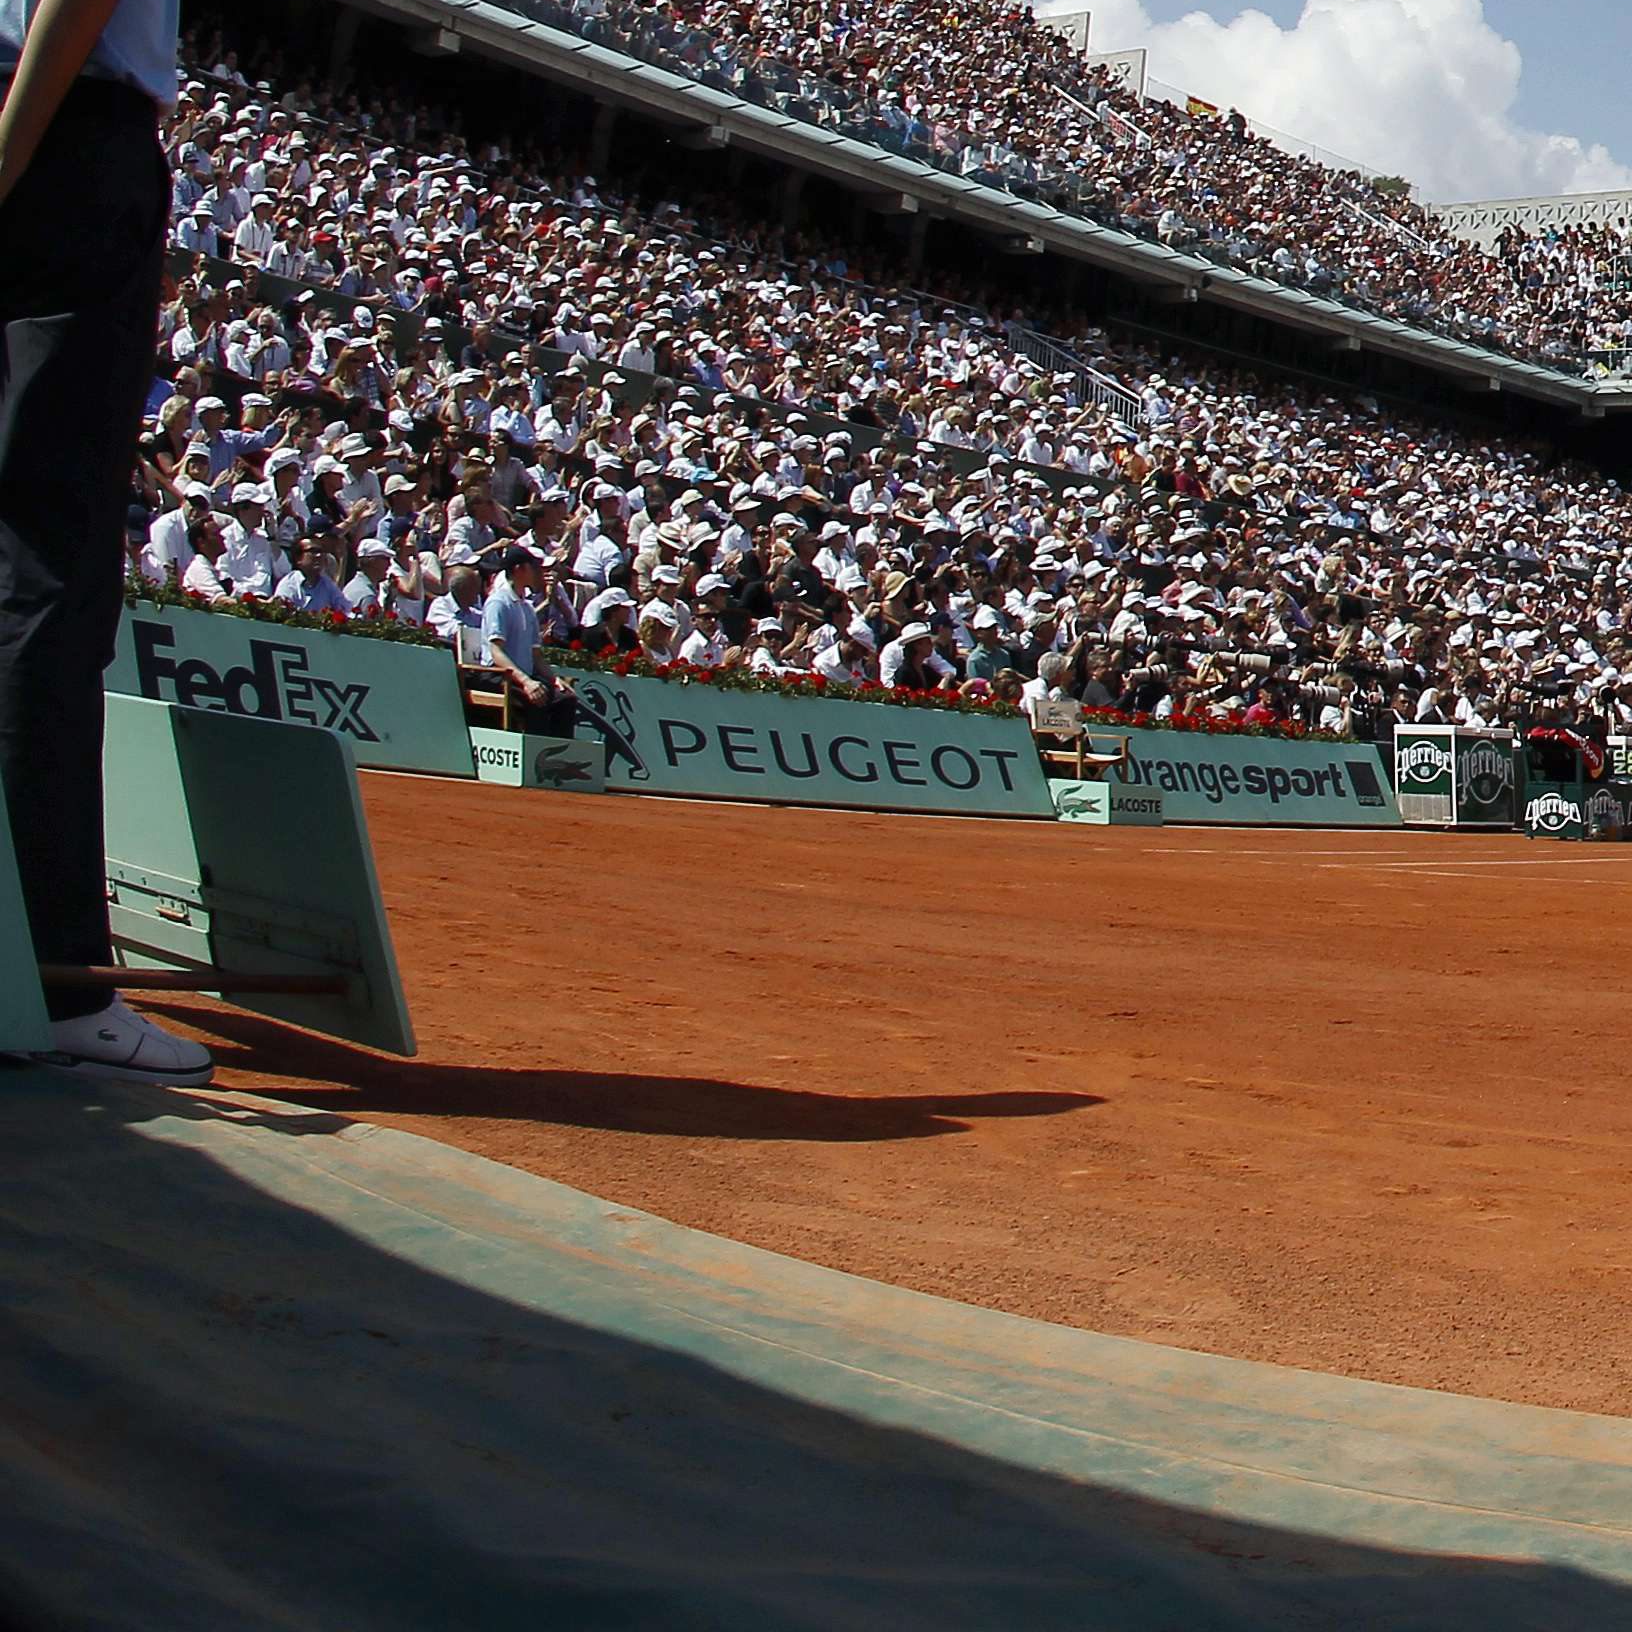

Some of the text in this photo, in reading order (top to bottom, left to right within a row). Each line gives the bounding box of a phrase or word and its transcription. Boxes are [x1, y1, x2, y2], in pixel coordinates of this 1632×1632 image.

[132, 619, 381, 742] FedEx
[472, 745, 520, 768] ACOSTE
[658, 718, 1018, 792] PEUGEOT
[1242, 762, 1347, 804] sport
[1111, 797, 1161, 814] LACOSTE
